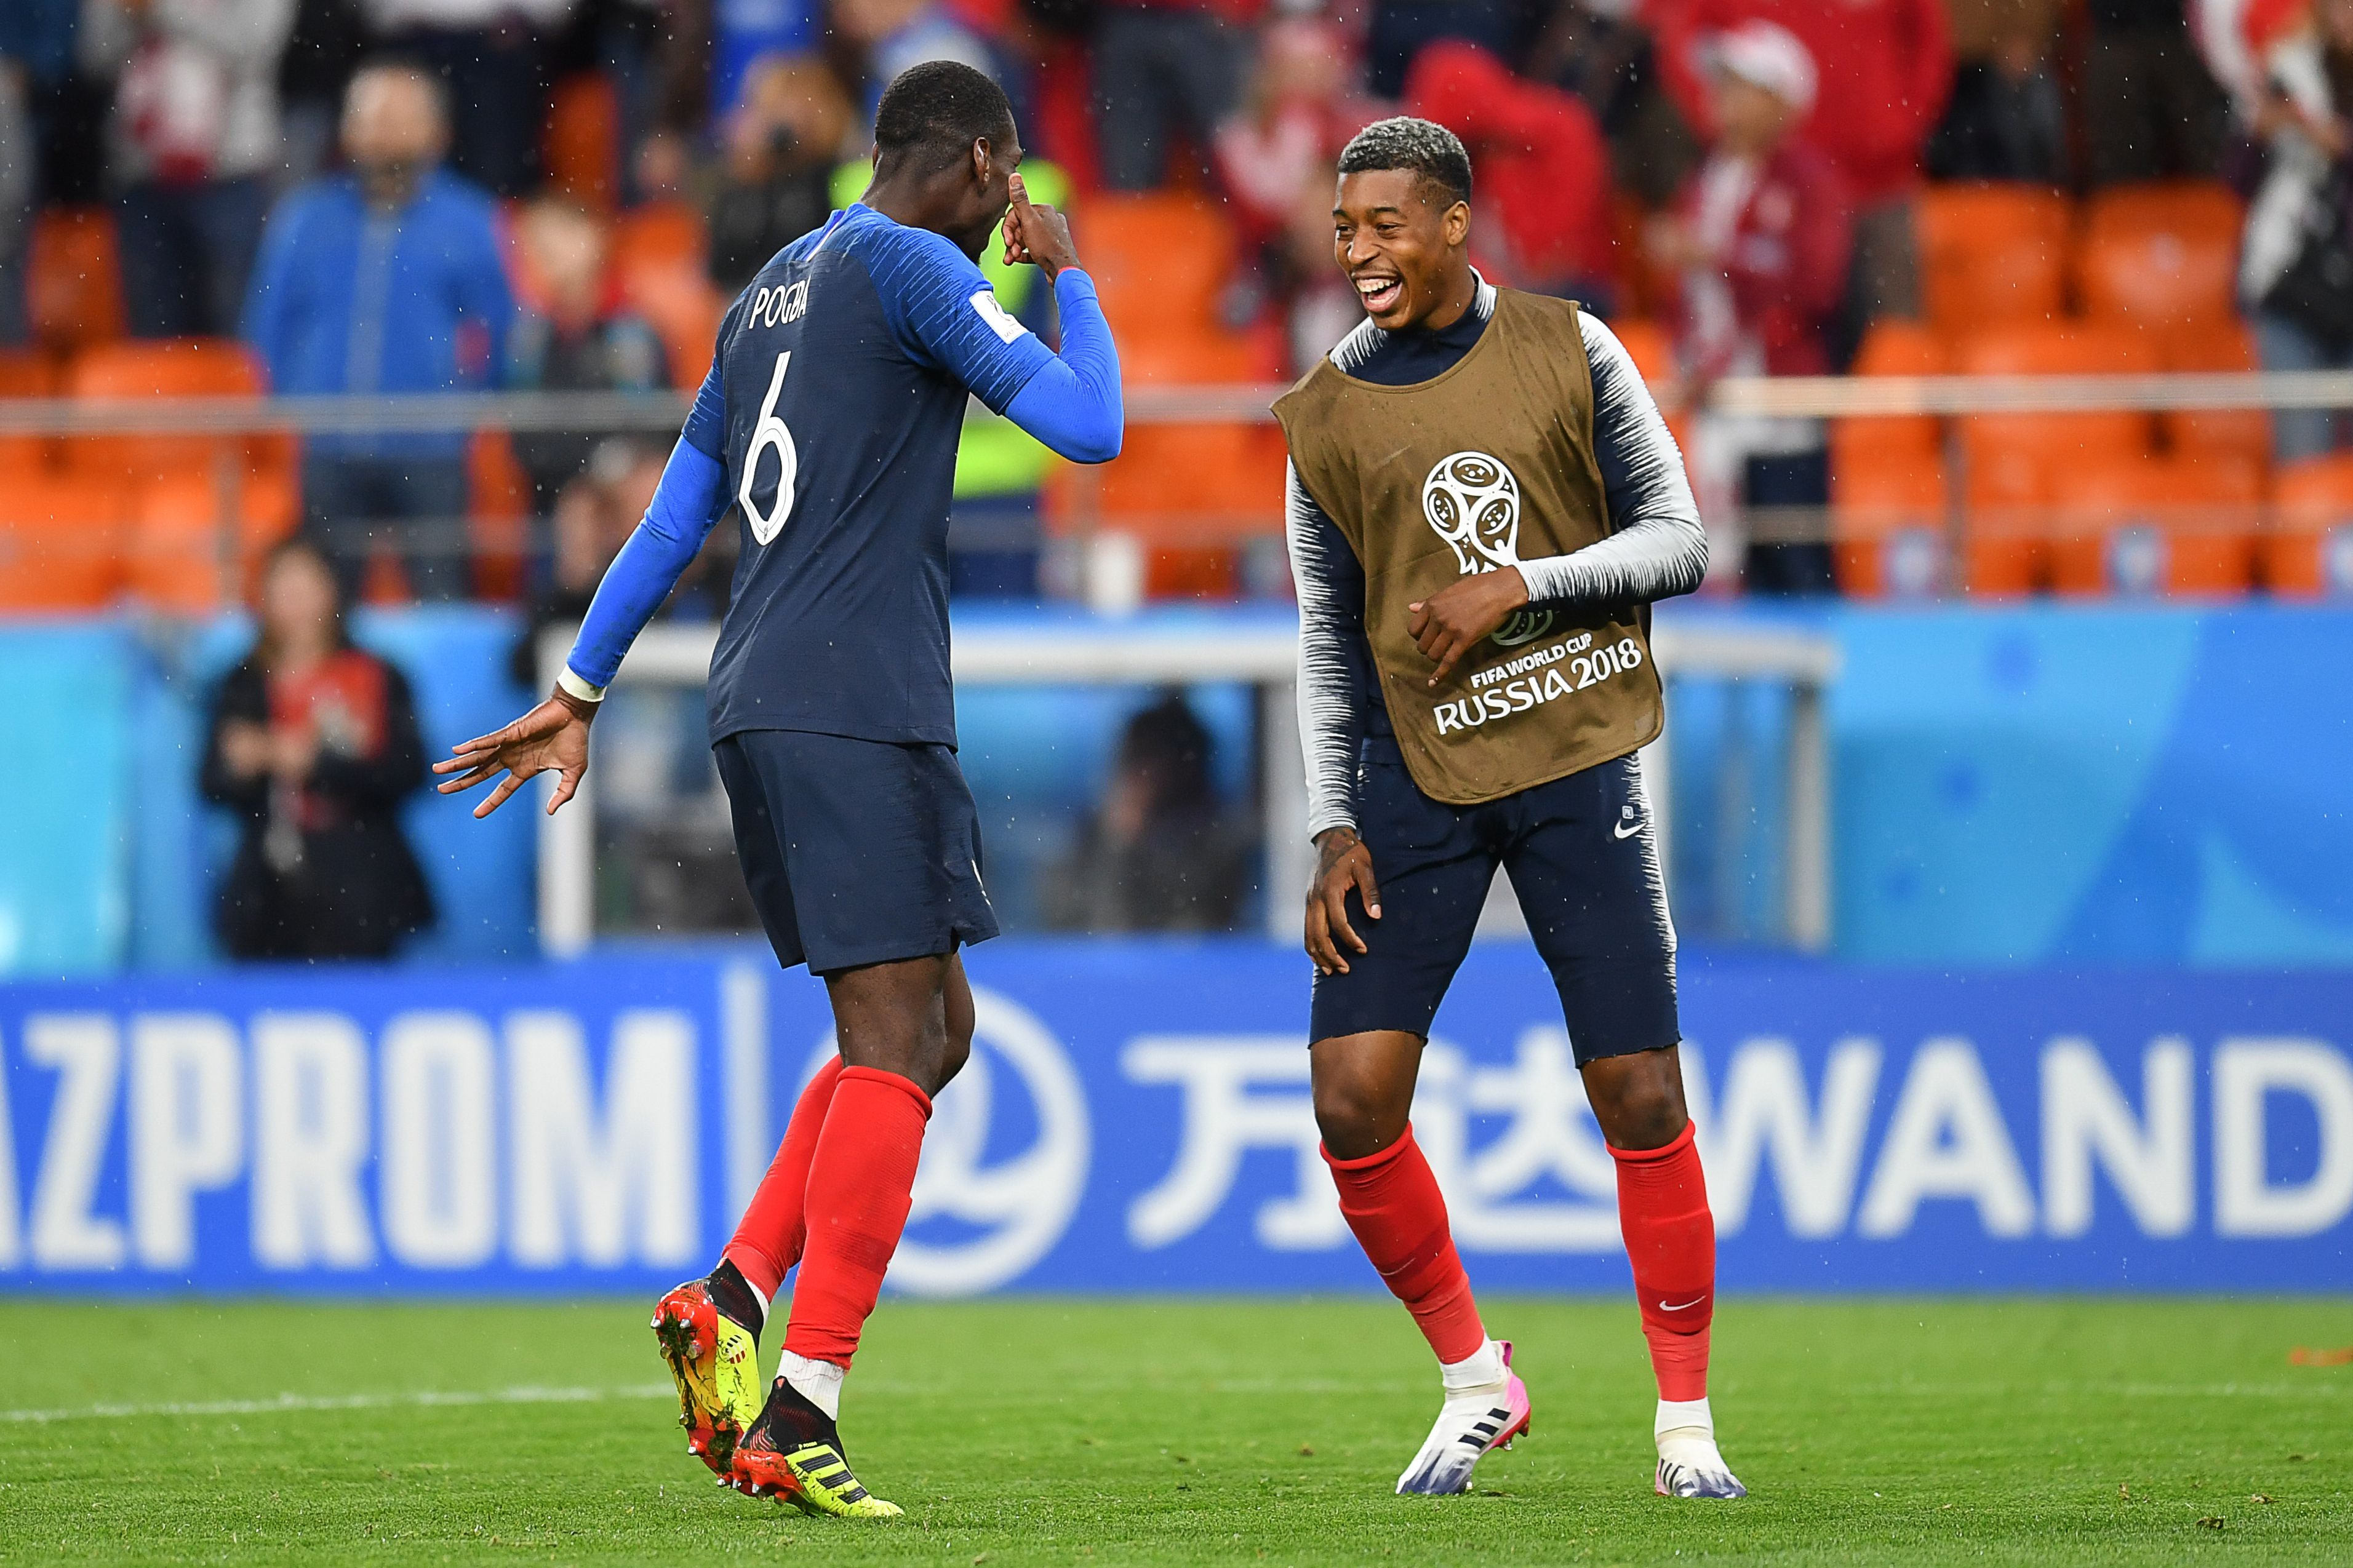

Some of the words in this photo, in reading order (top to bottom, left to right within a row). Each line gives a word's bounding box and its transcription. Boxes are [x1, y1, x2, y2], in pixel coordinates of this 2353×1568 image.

[748, 274, 812, 329] POGBA
[738, 350, 797, 546] 6
[1432, 668, 1575, 736] RUSSIA
[1570, 637, 1642, 690] 2018
[1470, 667, 1509, 689] FIFA
[1505, 644, 1566, 677] WORLD
[1567, 632, 1592, 654] CUP
[0, 1009, 700, 1271] ZPROM
